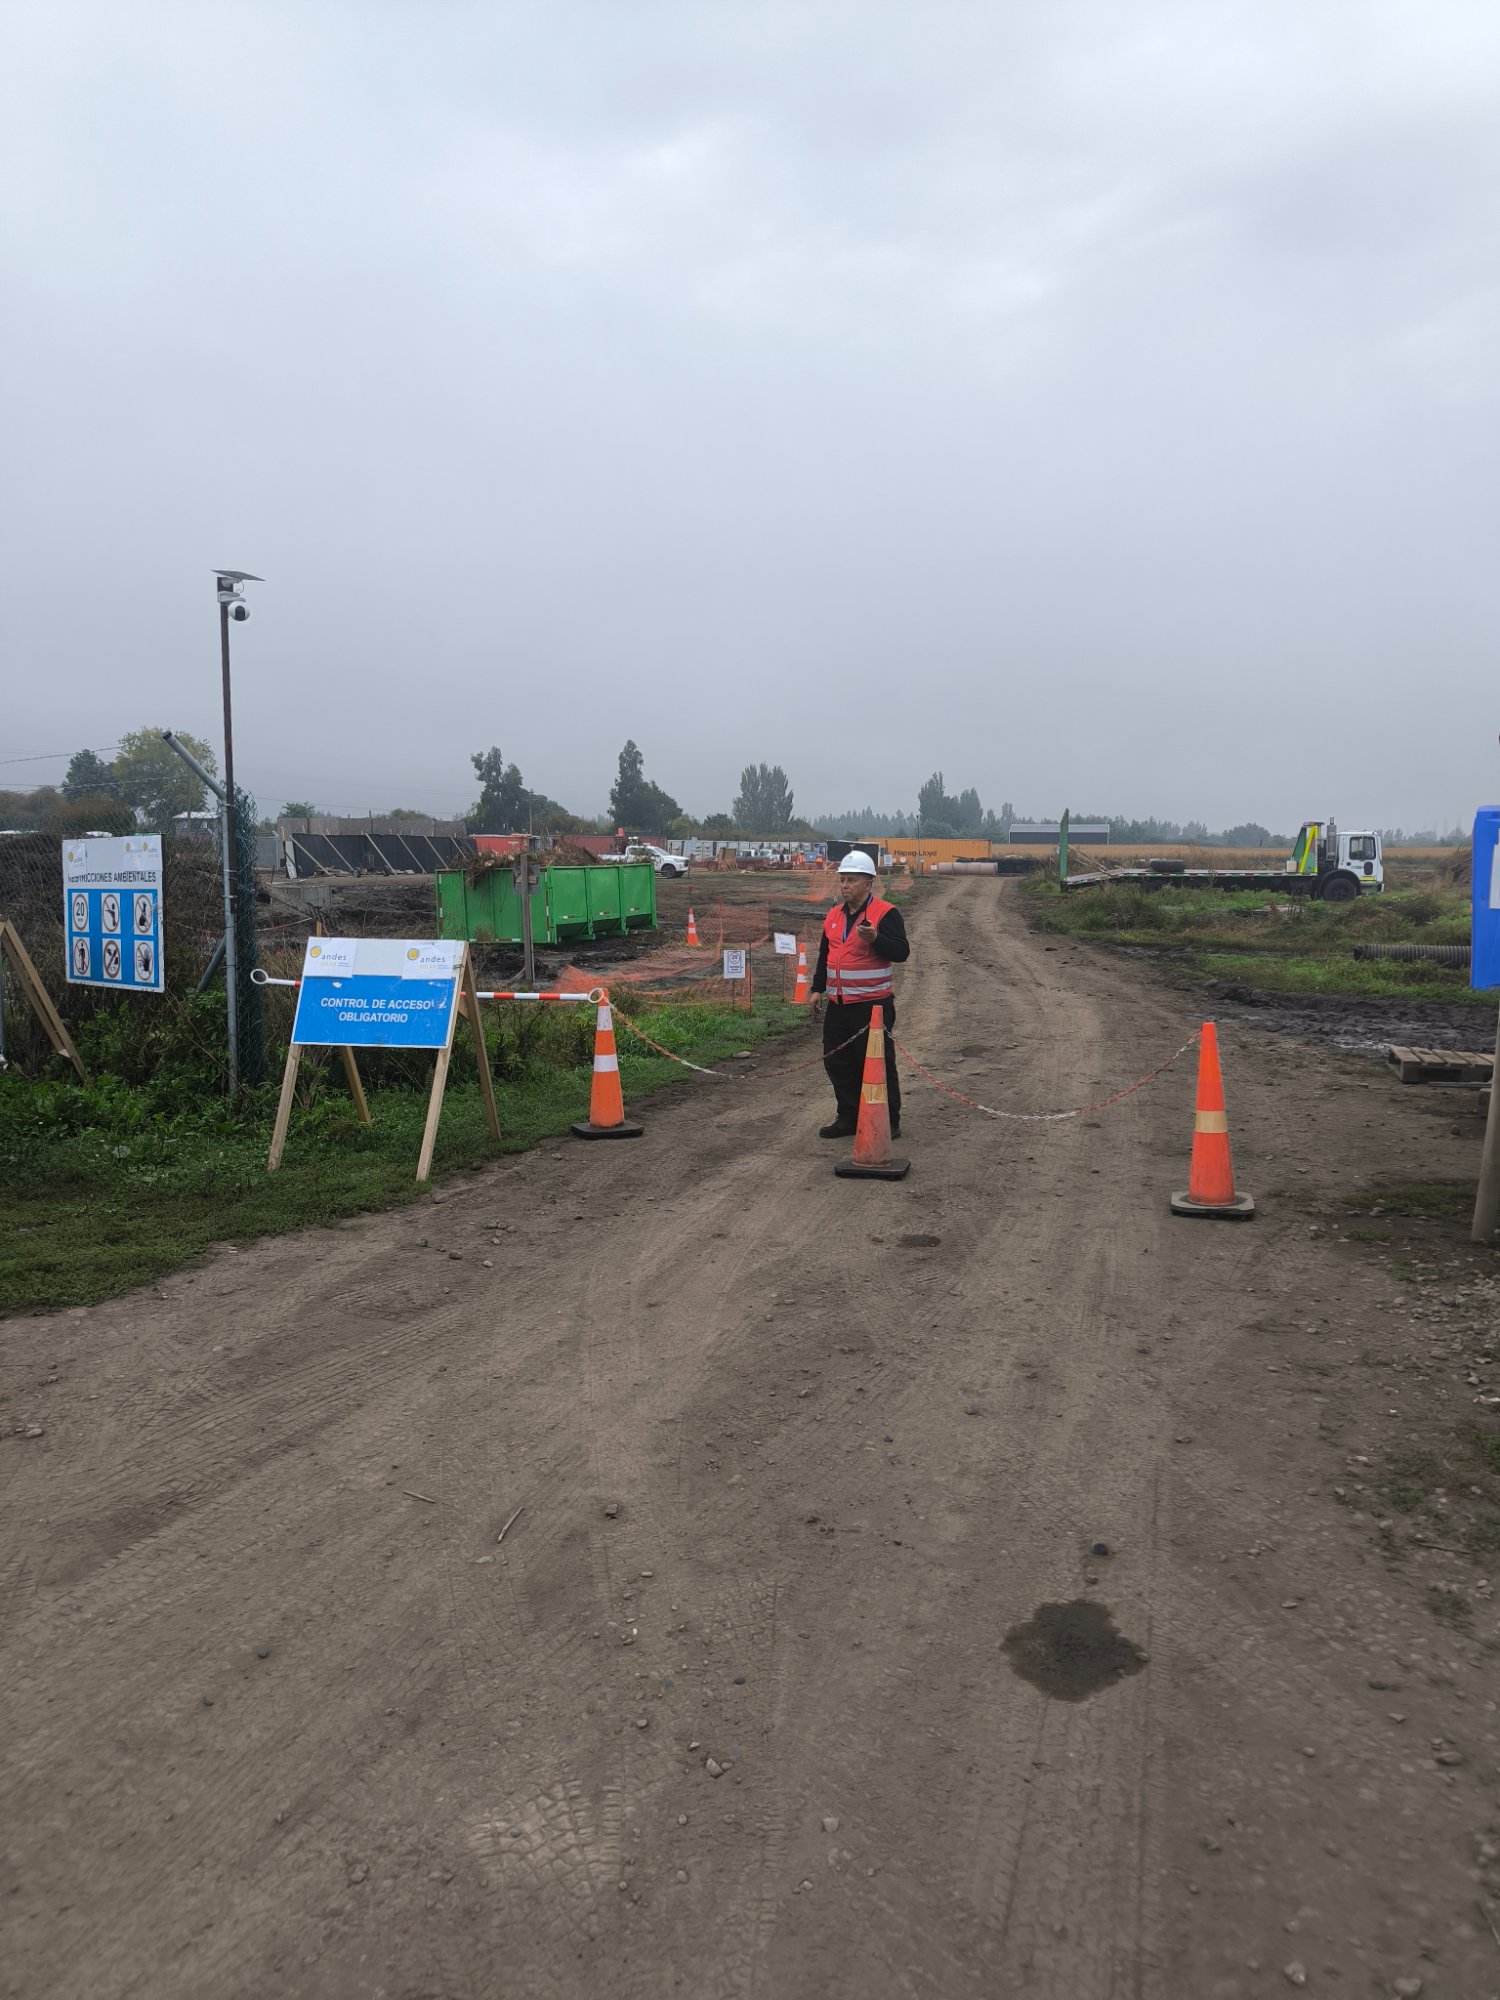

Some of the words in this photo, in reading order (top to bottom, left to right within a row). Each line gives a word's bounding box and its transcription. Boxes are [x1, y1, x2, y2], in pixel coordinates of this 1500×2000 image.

[114, 871, 156, 883] AMBIENTALES
[76, 902, 85, 917] 20
[321, 953, 347, 961] andes
[320, 997, 369, 1009] CONTROL
[372, 998, 386, 1009] DE
[388, 999, 431, 1010] ACCESO
[338, 1011, 408, 1023] OBLIGATORIO
